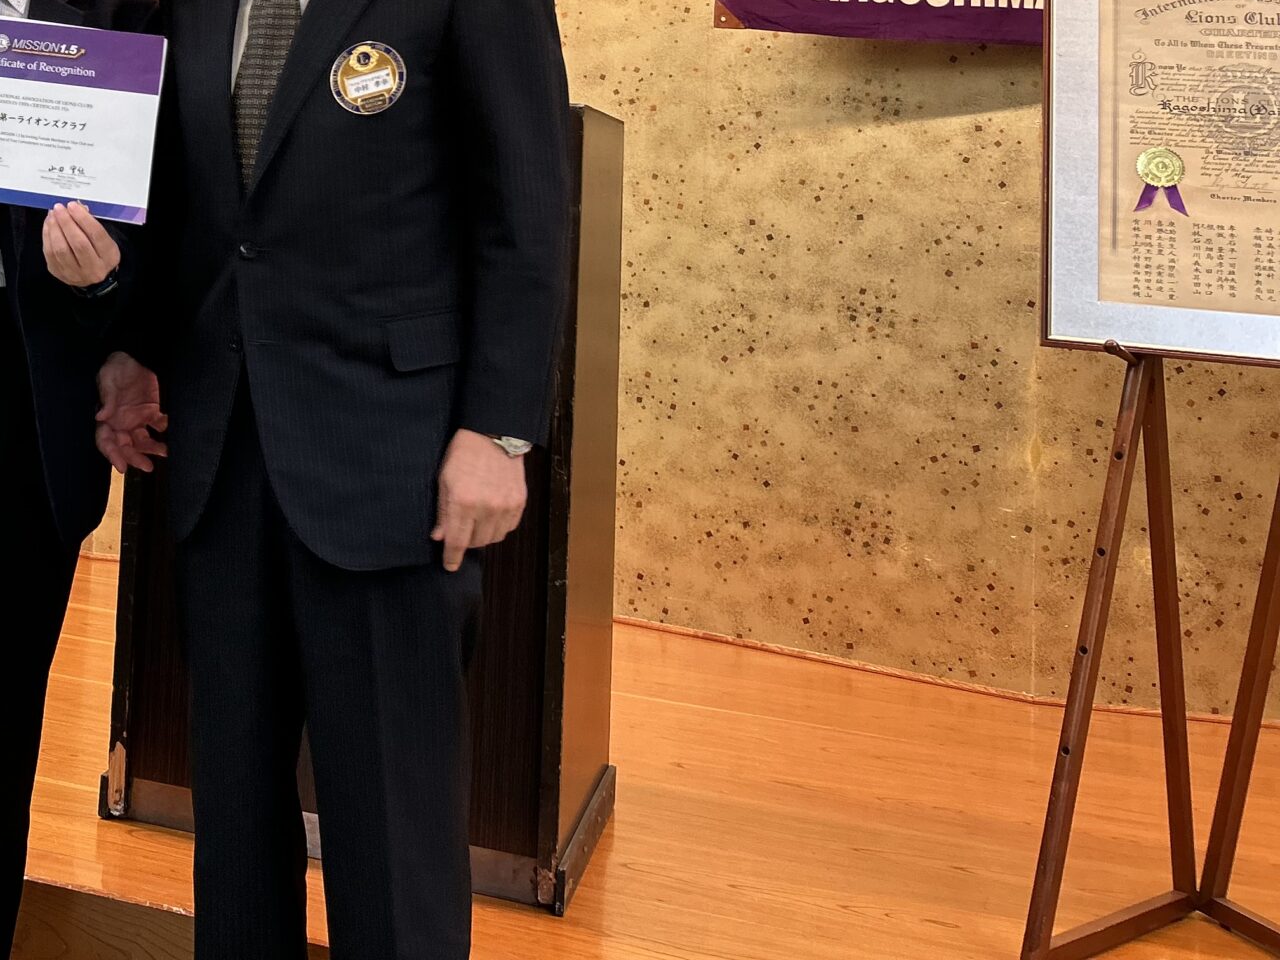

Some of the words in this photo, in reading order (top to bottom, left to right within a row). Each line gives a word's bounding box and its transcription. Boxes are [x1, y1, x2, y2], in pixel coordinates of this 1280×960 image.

[1184, 9, 1237, 25] Lions
[27, 60, 38, 71] of
[39, 61, 96, 78] Recognition
